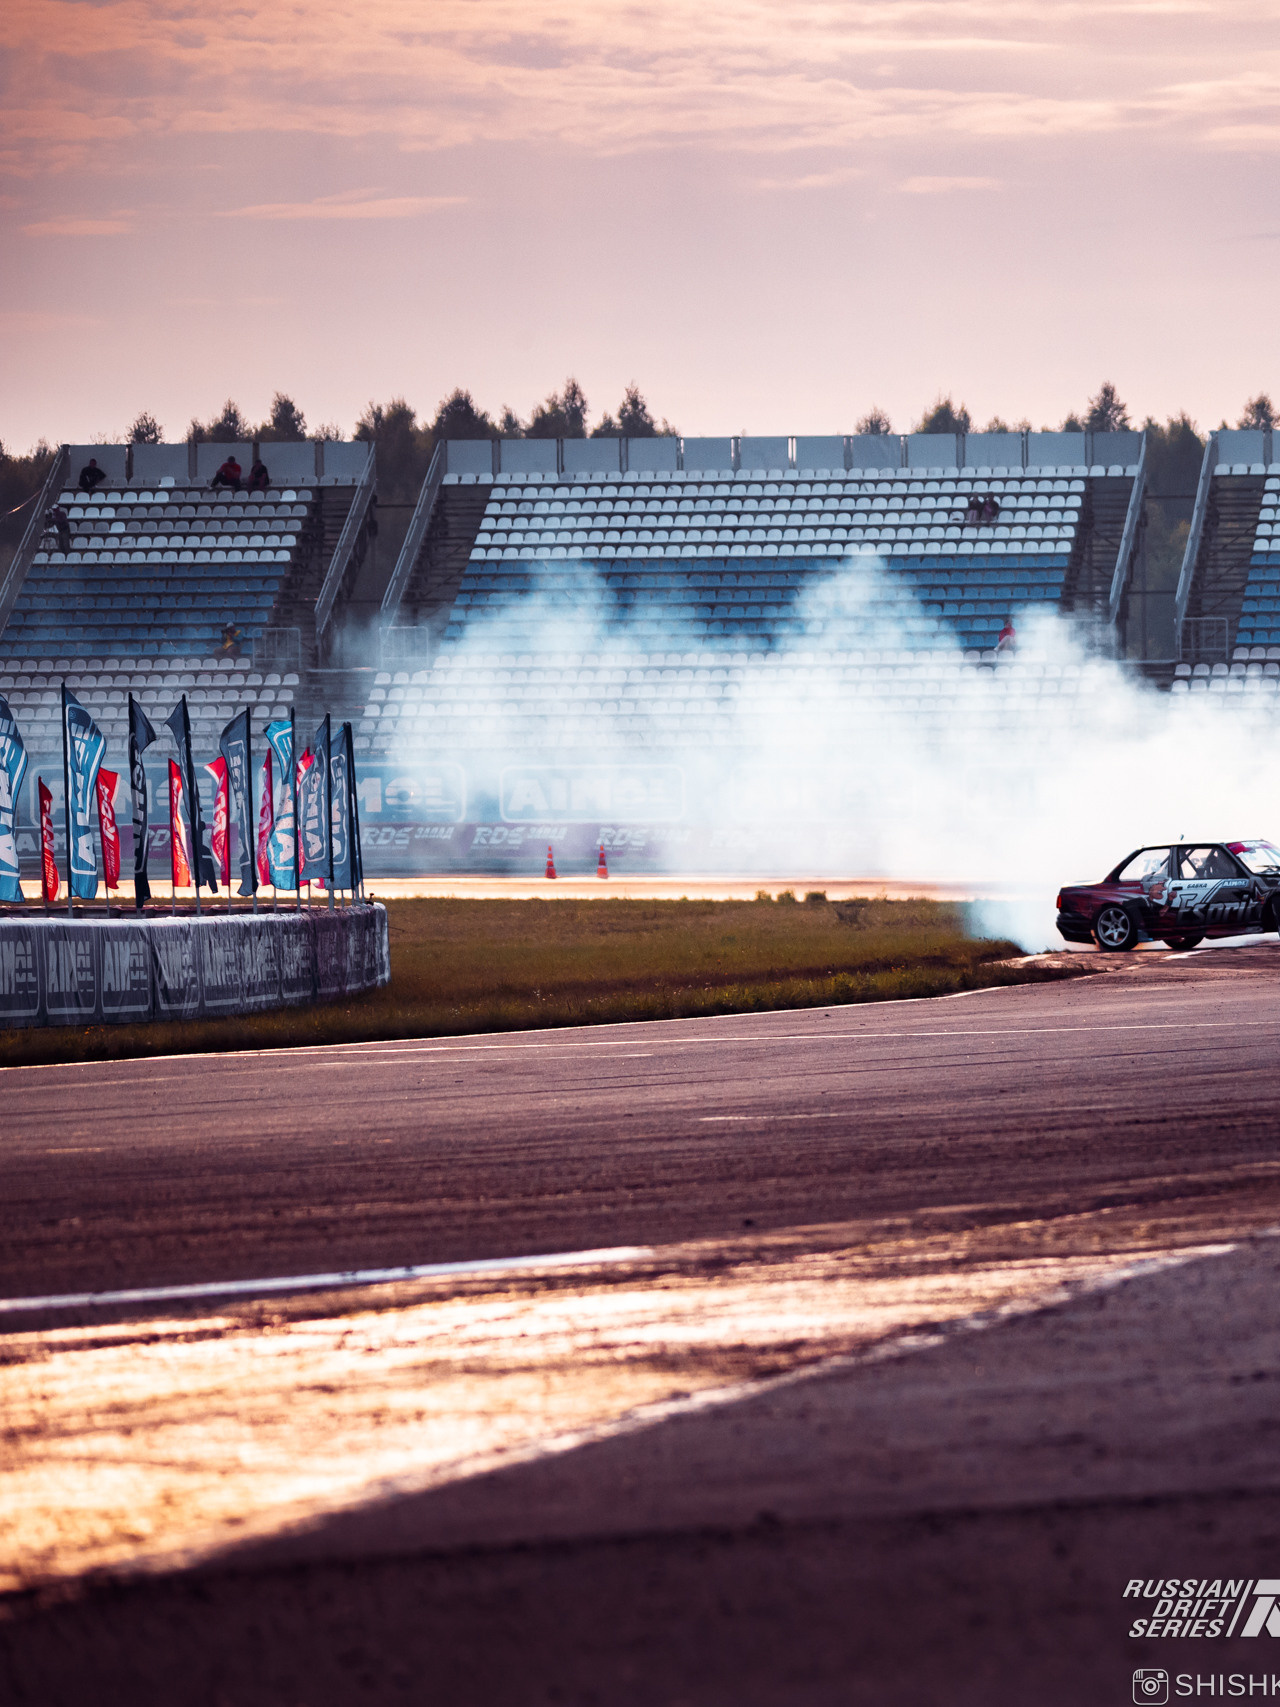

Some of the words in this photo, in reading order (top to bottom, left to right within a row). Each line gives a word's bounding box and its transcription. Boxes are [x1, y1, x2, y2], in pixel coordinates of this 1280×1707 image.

[507, 776, 678, 813] AIMOL
[362, 826, 414, 845] RDS
[472, 826, 526, 845] RDS
[596, 827, 650, 846] RDS
[48, 940, 94, 993] AIMOL
[103, 940, 148, 992] AIMOL
